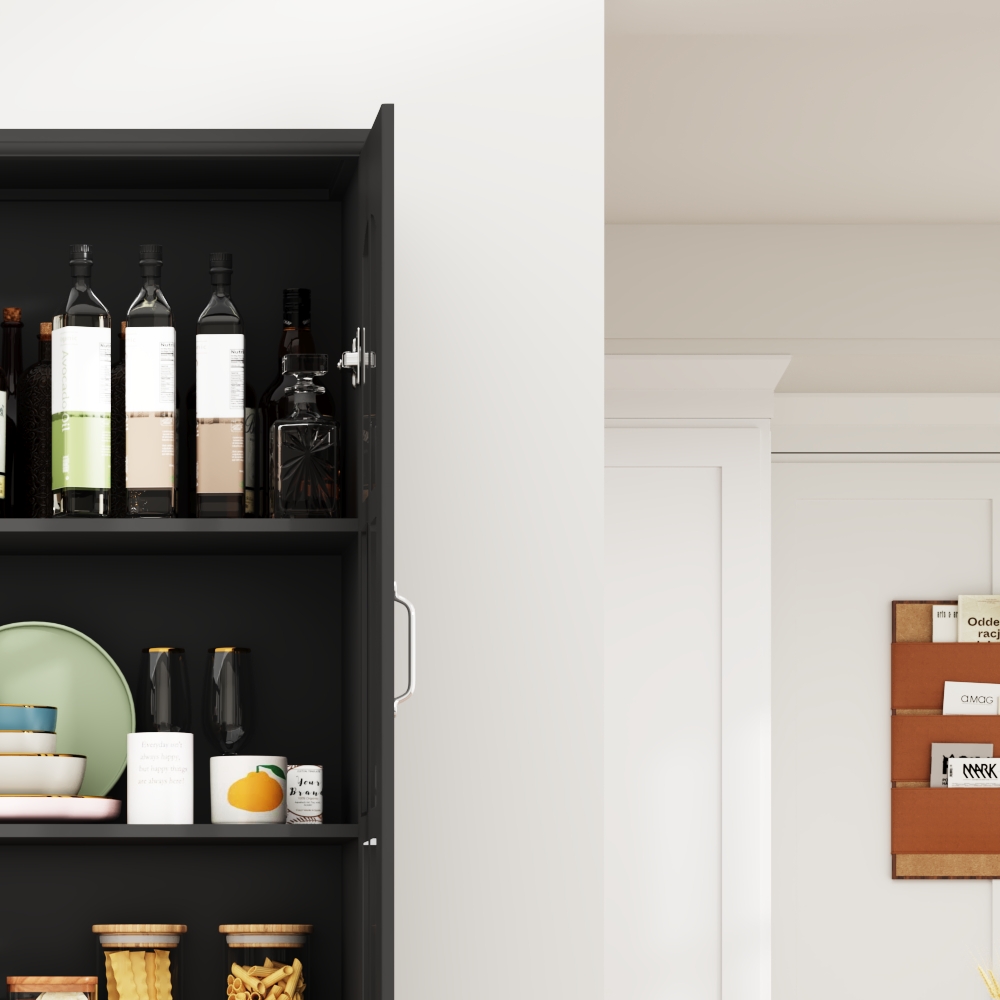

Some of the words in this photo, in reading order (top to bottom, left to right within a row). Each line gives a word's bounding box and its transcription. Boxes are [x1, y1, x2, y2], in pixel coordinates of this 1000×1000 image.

[61, 350, 70, 410] Avocado
[967, 617, 1000, 627] Odde
[962, 763, 998, 779] MARK
